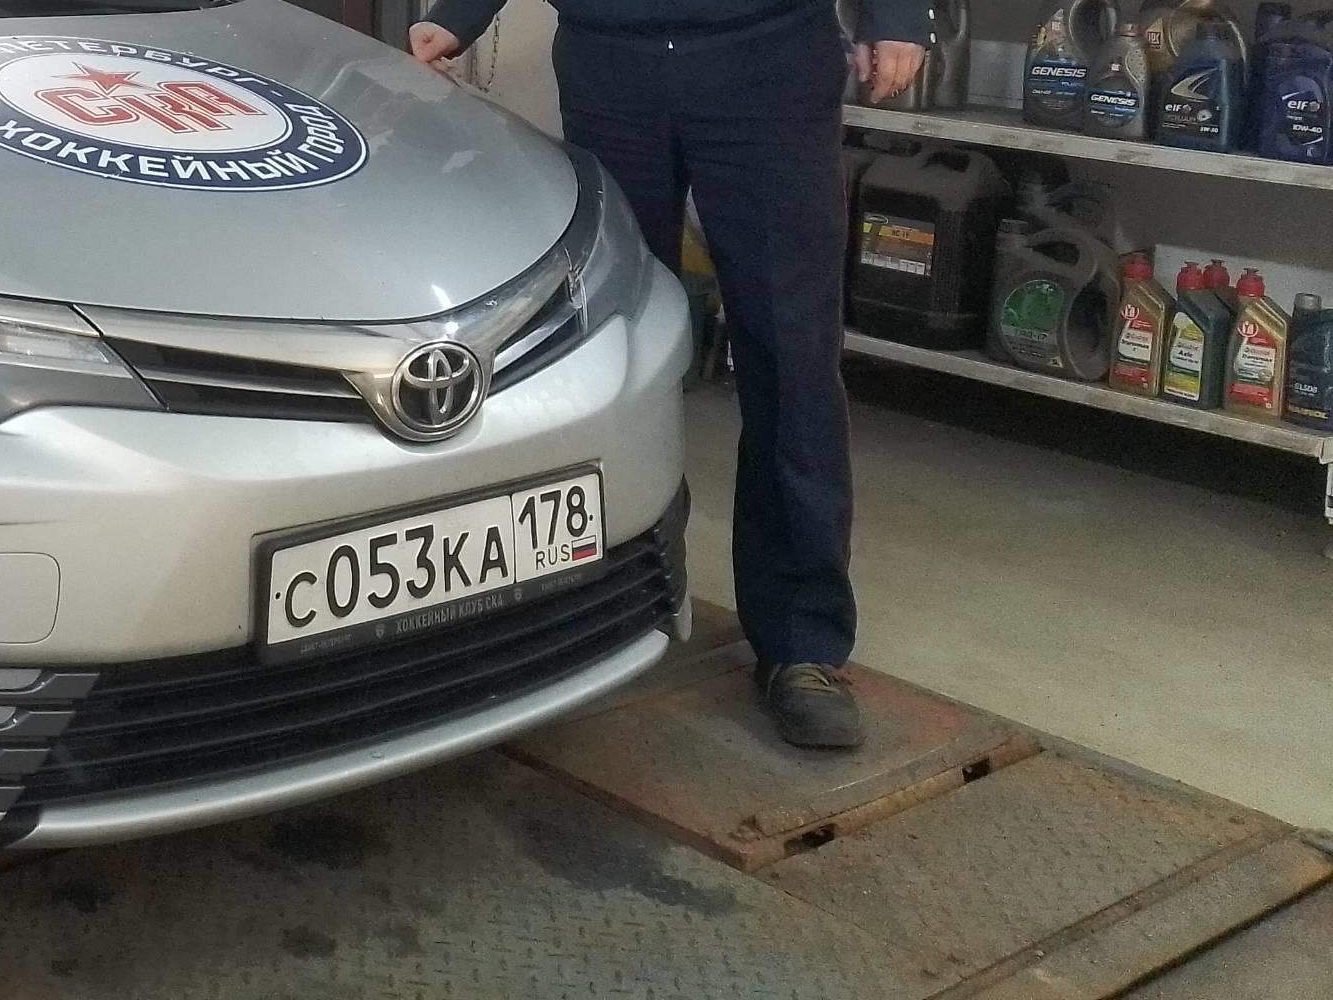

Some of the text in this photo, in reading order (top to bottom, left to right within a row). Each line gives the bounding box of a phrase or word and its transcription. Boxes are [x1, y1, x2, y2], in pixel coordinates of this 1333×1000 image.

[1031, 66, 1087, 78] GENESIS
[36, 80, 268, 135] СКА
[1090, 94, 1137, 106] GENESIS
[1165, 104, 1182, 112] elf
[1287, 100, 1309, 112] elf
[301, 103, 345, 164] ГОРОД
[1292, 124, 1323, 135] 10W-40
[284, 486, 588, 628] С053КА 178
[535, 543, 571, 571] RUS
[395, 593, 504, 634] ХОККЕЙНЫЙ КЛУБ СКА
